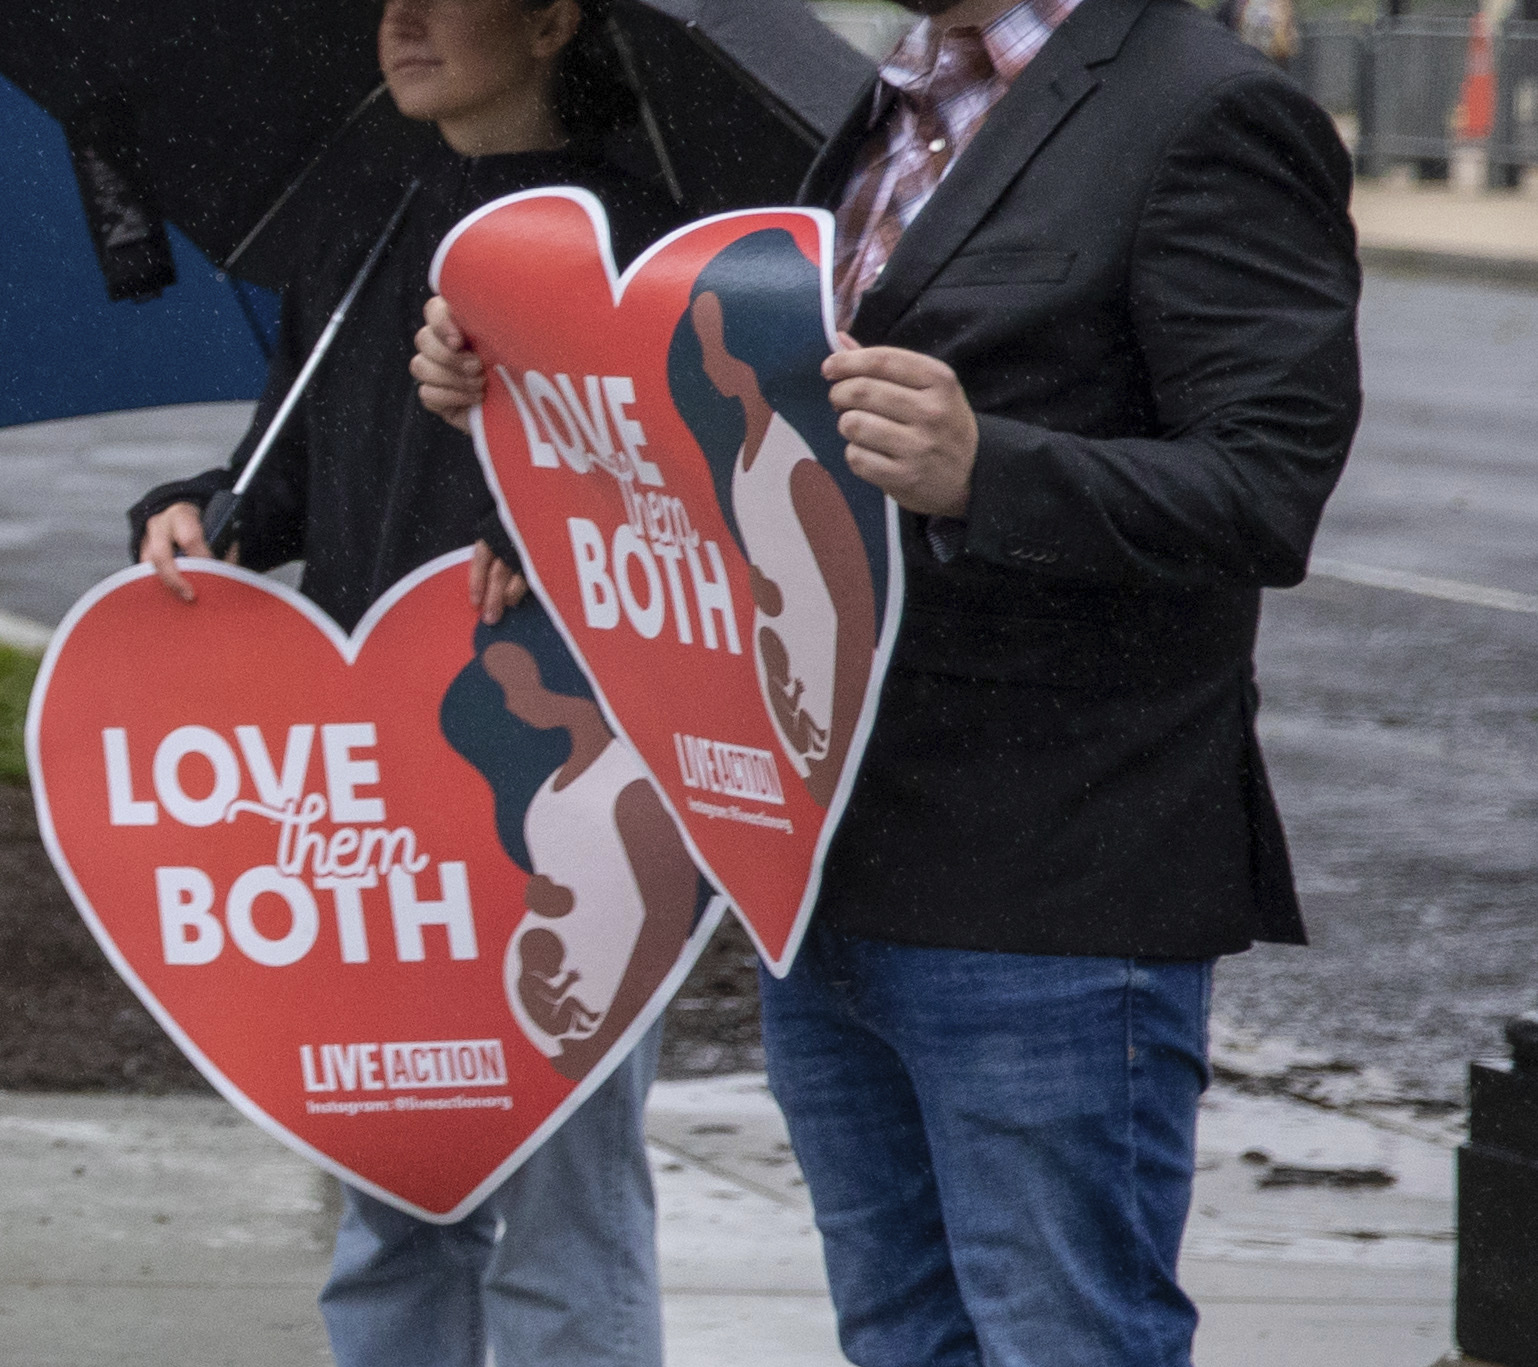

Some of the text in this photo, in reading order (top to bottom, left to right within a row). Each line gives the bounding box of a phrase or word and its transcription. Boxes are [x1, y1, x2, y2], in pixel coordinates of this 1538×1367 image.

[496, 364, 665, 488] LOVE
[566, 516, 742, 656] BOTH
[102, 722, 385, 827] LOVE
[225, 792, 430, 876] them
[154, 861, 480, 967] BOTH
[300, 1042, 503, 1092] LIVE ACTION
